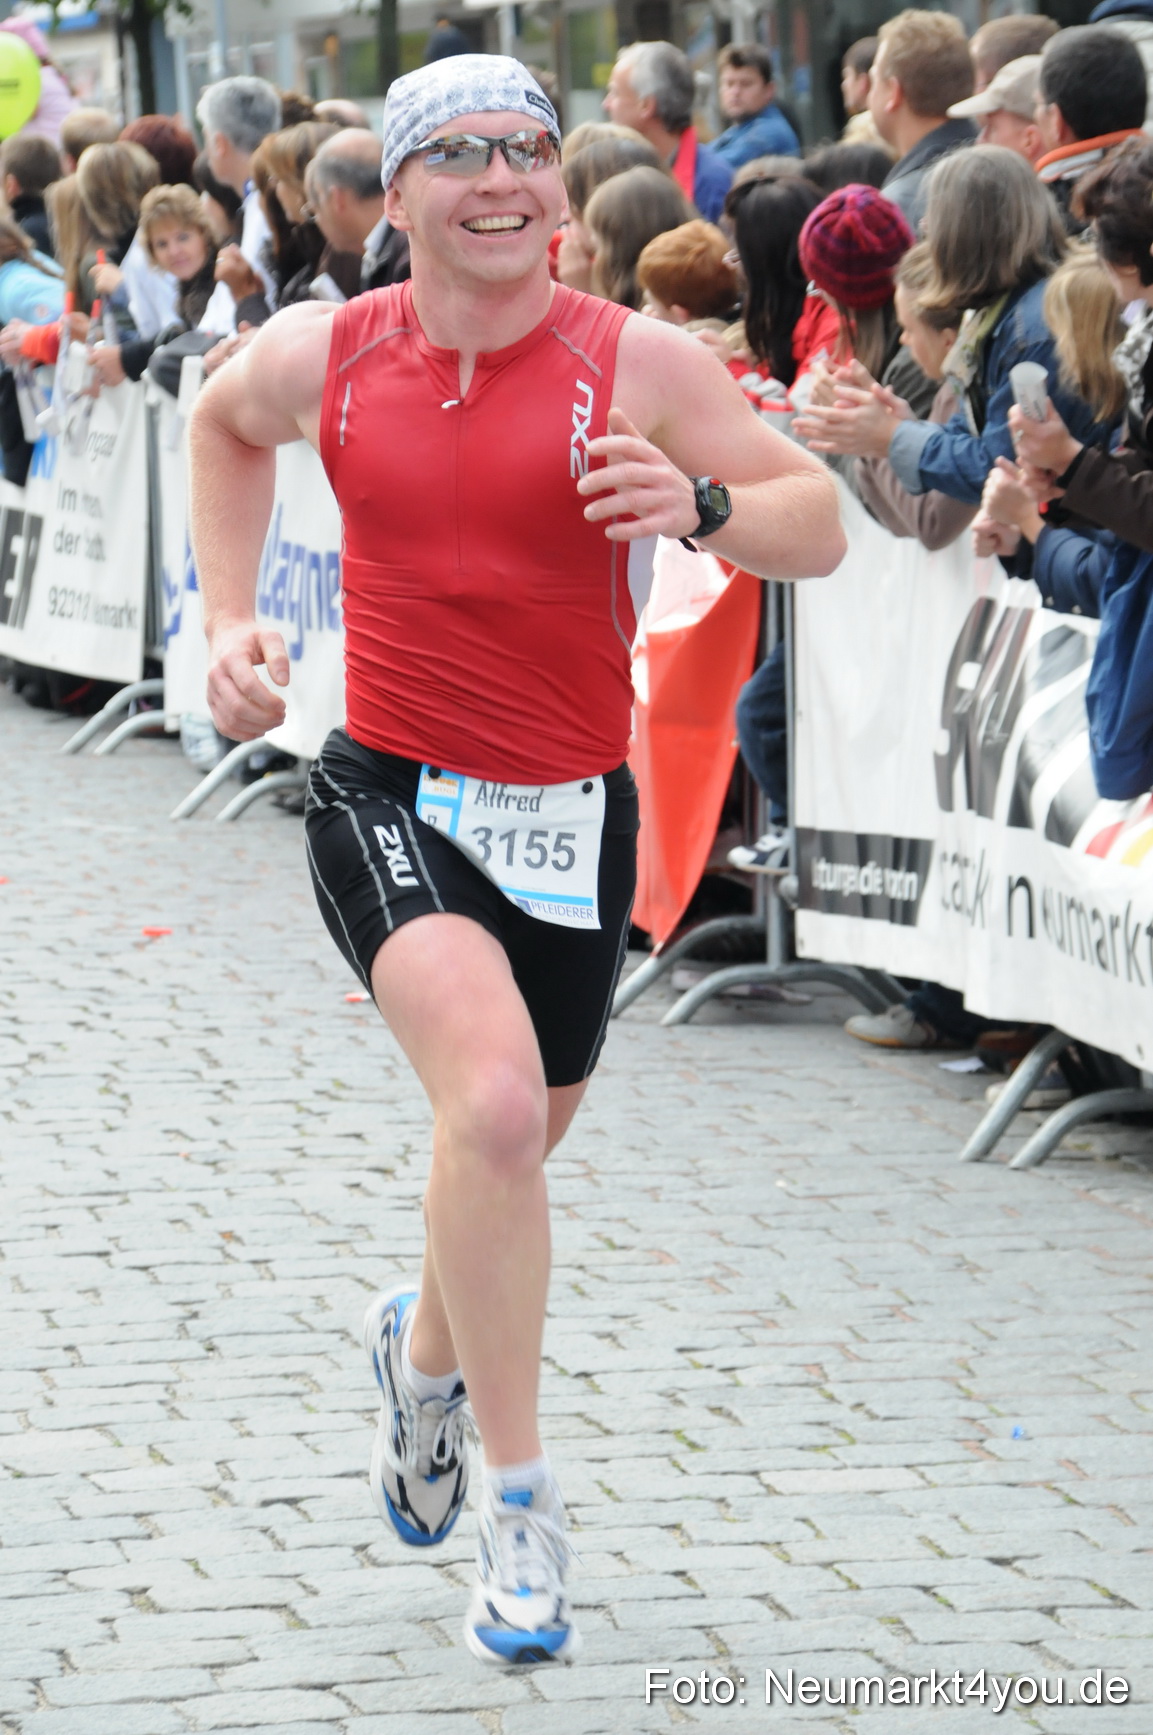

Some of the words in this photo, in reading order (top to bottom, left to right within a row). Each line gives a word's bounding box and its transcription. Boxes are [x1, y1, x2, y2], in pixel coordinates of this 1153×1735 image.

[570, 378, 594, 480] 2XU
[53, 522, 81, 557] der
[473, 780, 544, 813] Alfred
[373, 823, 420, 888] 2XU
[471, 826, 576, 872] 3155
[531, 901, 594, 920] PFLEIDERER
